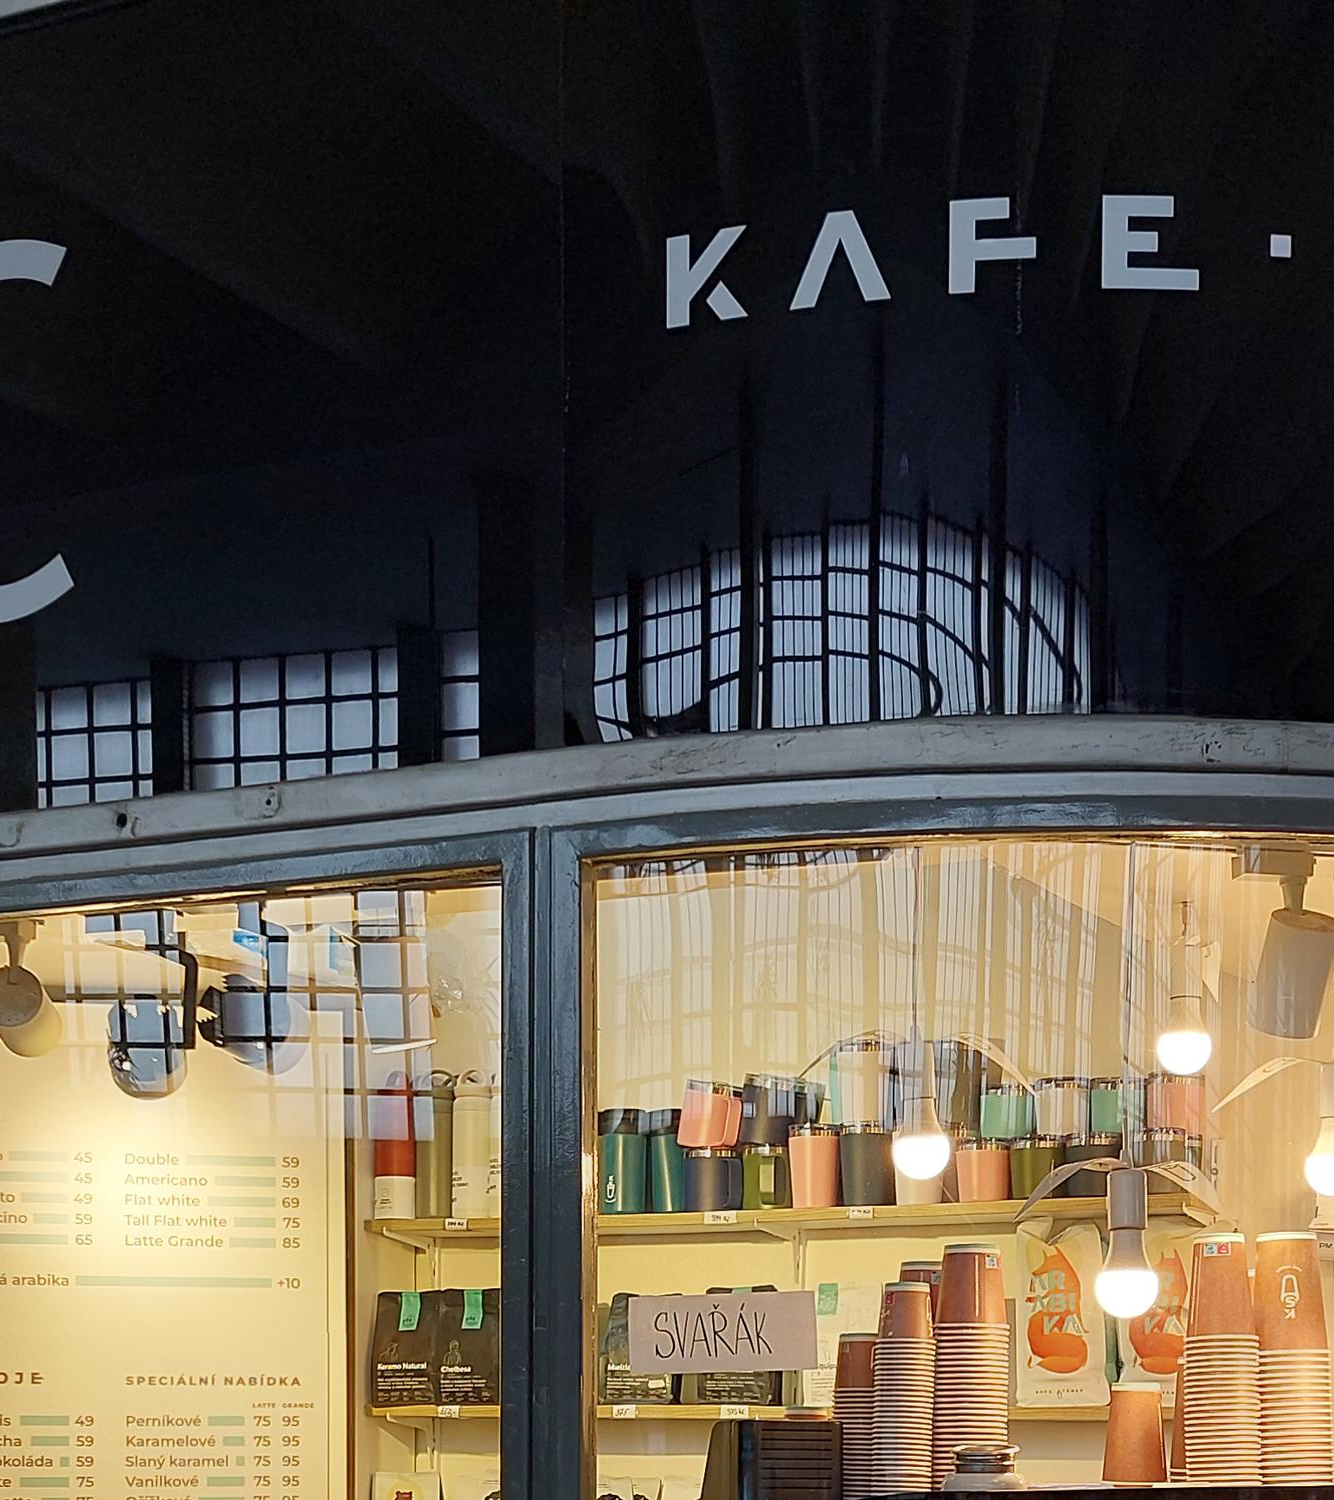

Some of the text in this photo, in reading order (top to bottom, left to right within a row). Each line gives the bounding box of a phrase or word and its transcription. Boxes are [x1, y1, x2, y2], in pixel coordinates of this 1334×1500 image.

[667, 195, 1199, 328] KAFE
[74, 1152, 93, 1163] 45
[124, 1153, 299, 1168] Double 59
[74, 1172, 93, 1184] 45
[124, 1173, 299, 1188] Americano 59
[74, 1193, 93, 1205] 49
[124, 1194, 299, 1208] Flat white 69
[74, 1213, 93, 1225] 59
[124, 1215, 301, 1229] Tall Flat white 75
[75, 1234, 93, 1245] 65
[124, 1235, 301, 1249] Latte Grande 85
[12, 1274, 70, 1286] arabika
[277, 1277, 301, 1289] +10
[654, 1302, 772, 1358] SVAŘÁK
[125, 1374, 302, 1387] SPECIÁLNÍ NABÍDKA
[75, 1416, 94, 1427] 49
[126, 1414, 300, 1427] Perníkové 75 95
[76, 1436, 94, 1447] 59
[126, 1435, 300, 1447] Karamelové 75 95
[76, 1456, 94, 1467] 59
[125, 1455, 300, 1470] Slaný karamel 75 95
[76, 1477, 94, 1487] 75
[125, 1475, 300, 1487] Vanilkové 75 95
